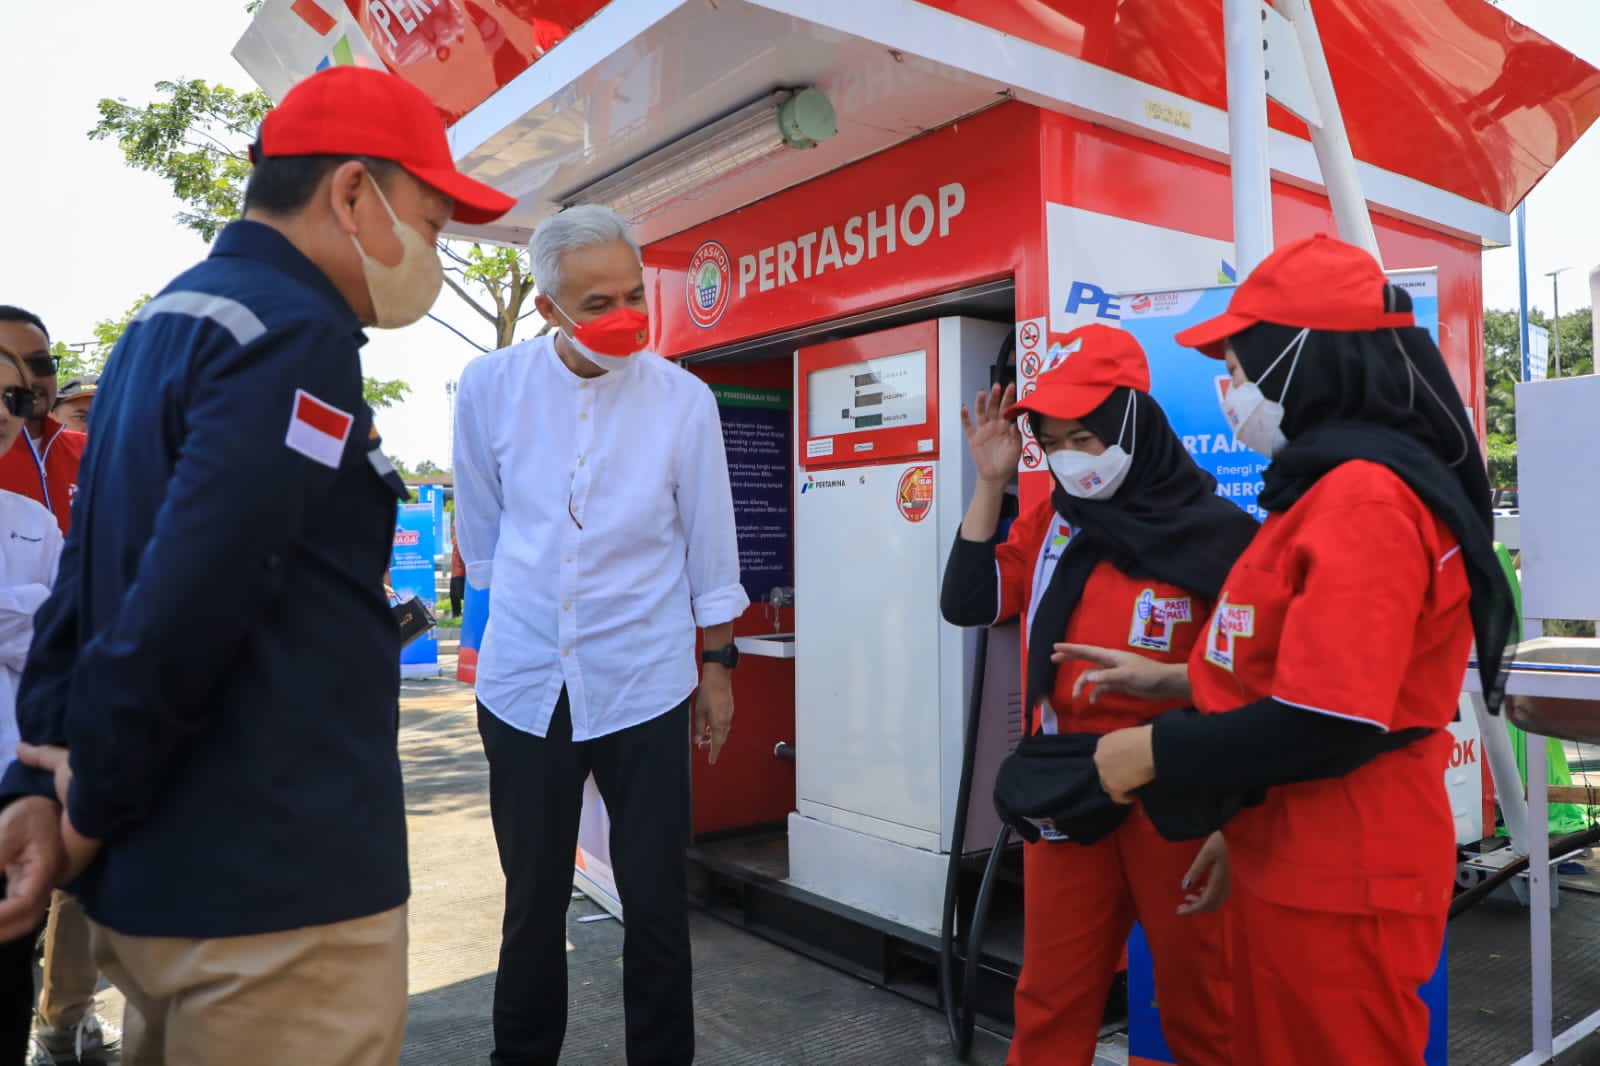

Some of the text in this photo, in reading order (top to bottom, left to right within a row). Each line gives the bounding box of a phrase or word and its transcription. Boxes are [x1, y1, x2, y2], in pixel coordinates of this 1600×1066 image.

[738, 182, 966, 298] PERTASHOP
[690, 247, 728, 285] PERTASHOP
[815, 479, 846, 489] PERTAMINA
[1217, 464, 1252, 477] Energi
[1450, 738, 1477, 768] OK
